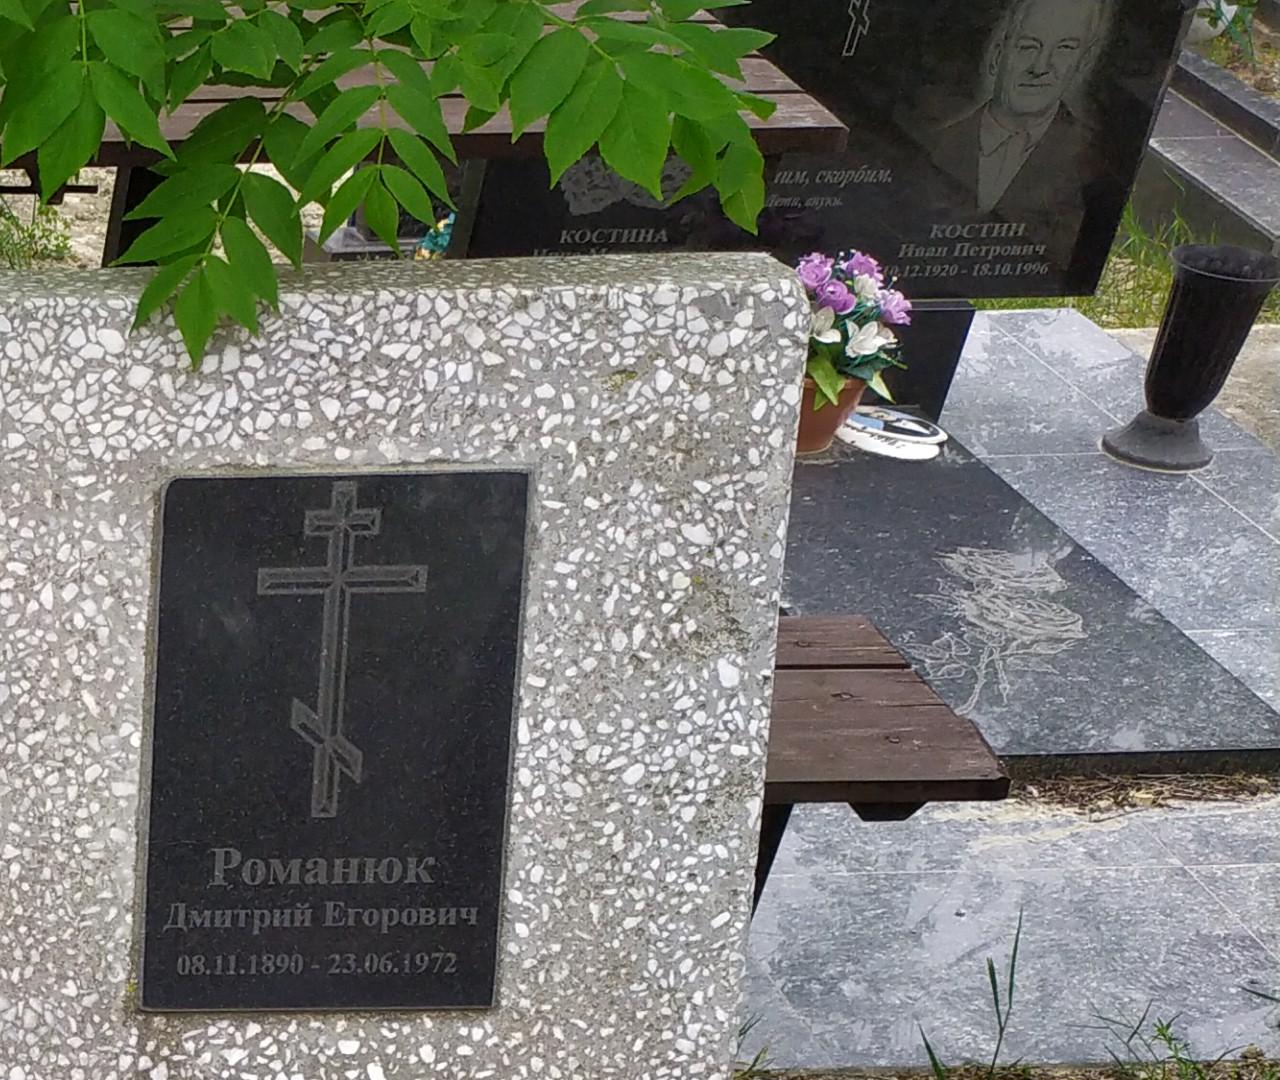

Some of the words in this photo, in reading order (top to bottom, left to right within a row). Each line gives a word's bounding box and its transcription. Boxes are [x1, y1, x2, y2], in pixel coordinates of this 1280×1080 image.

[559, 228, 669, 244] КОСТИНА
[929, 222, 1027, 240] КОСТИН
[897, 243, 949, 258] Иван
[953, 242, 1048, 260] Петрович
[207, 847, 438, 887] Романюк
[162, 902, 313, 935] Дмитрий
[321, 901, 479, 934] Егорович
[176, 953, 304, 976] 08.11.1890
[326, 952, 458, 975] 23.06.1972
